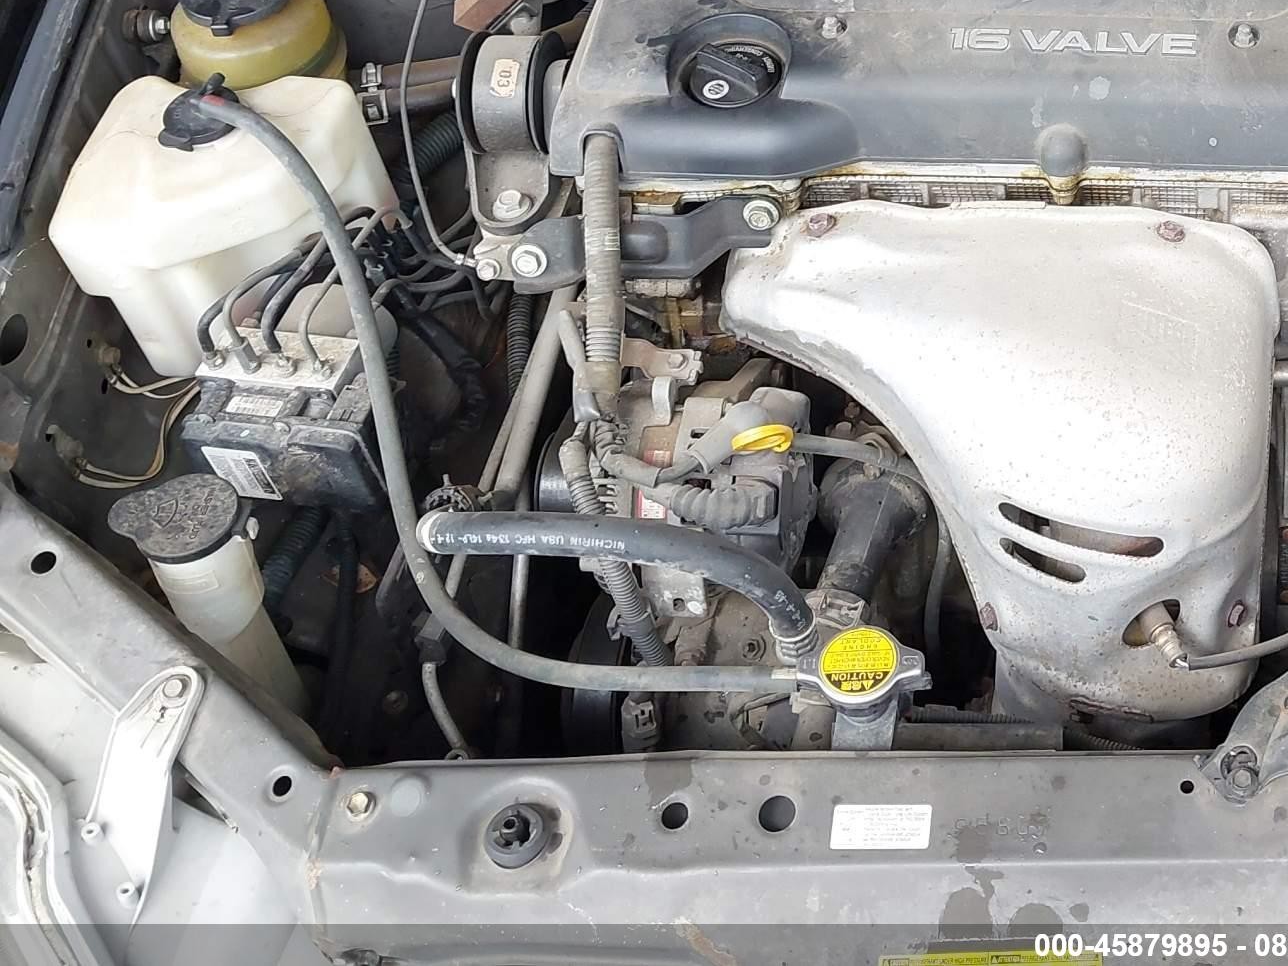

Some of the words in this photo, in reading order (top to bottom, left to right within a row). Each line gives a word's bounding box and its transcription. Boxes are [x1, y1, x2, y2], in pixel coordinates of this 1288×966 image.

[950, 26, 1010, 52] 16
[1020, 28, 1198, 56] VALVE
[515, 535, 536, 544] HFC
[541, 535, 564, 545] USA
[831, 672, 884, 682] CAUTION
